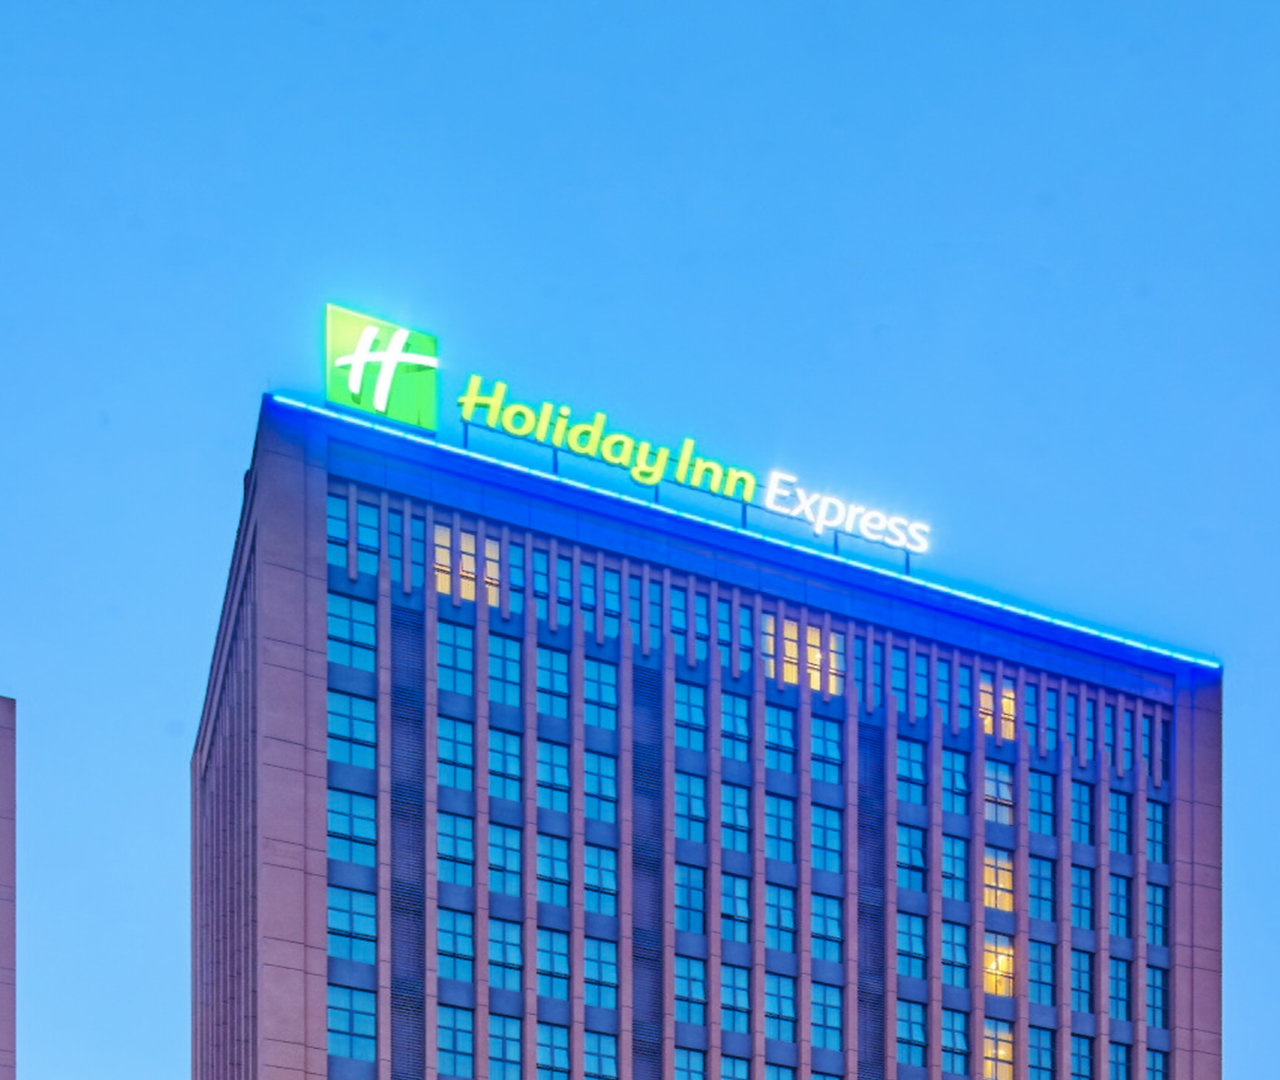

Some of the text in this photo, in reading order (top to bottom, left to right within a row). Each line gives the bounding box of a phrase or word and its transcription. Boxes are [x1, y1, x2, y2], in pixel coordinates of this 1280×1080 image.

[457, 374, 931, 553] Holiday Inn Express
